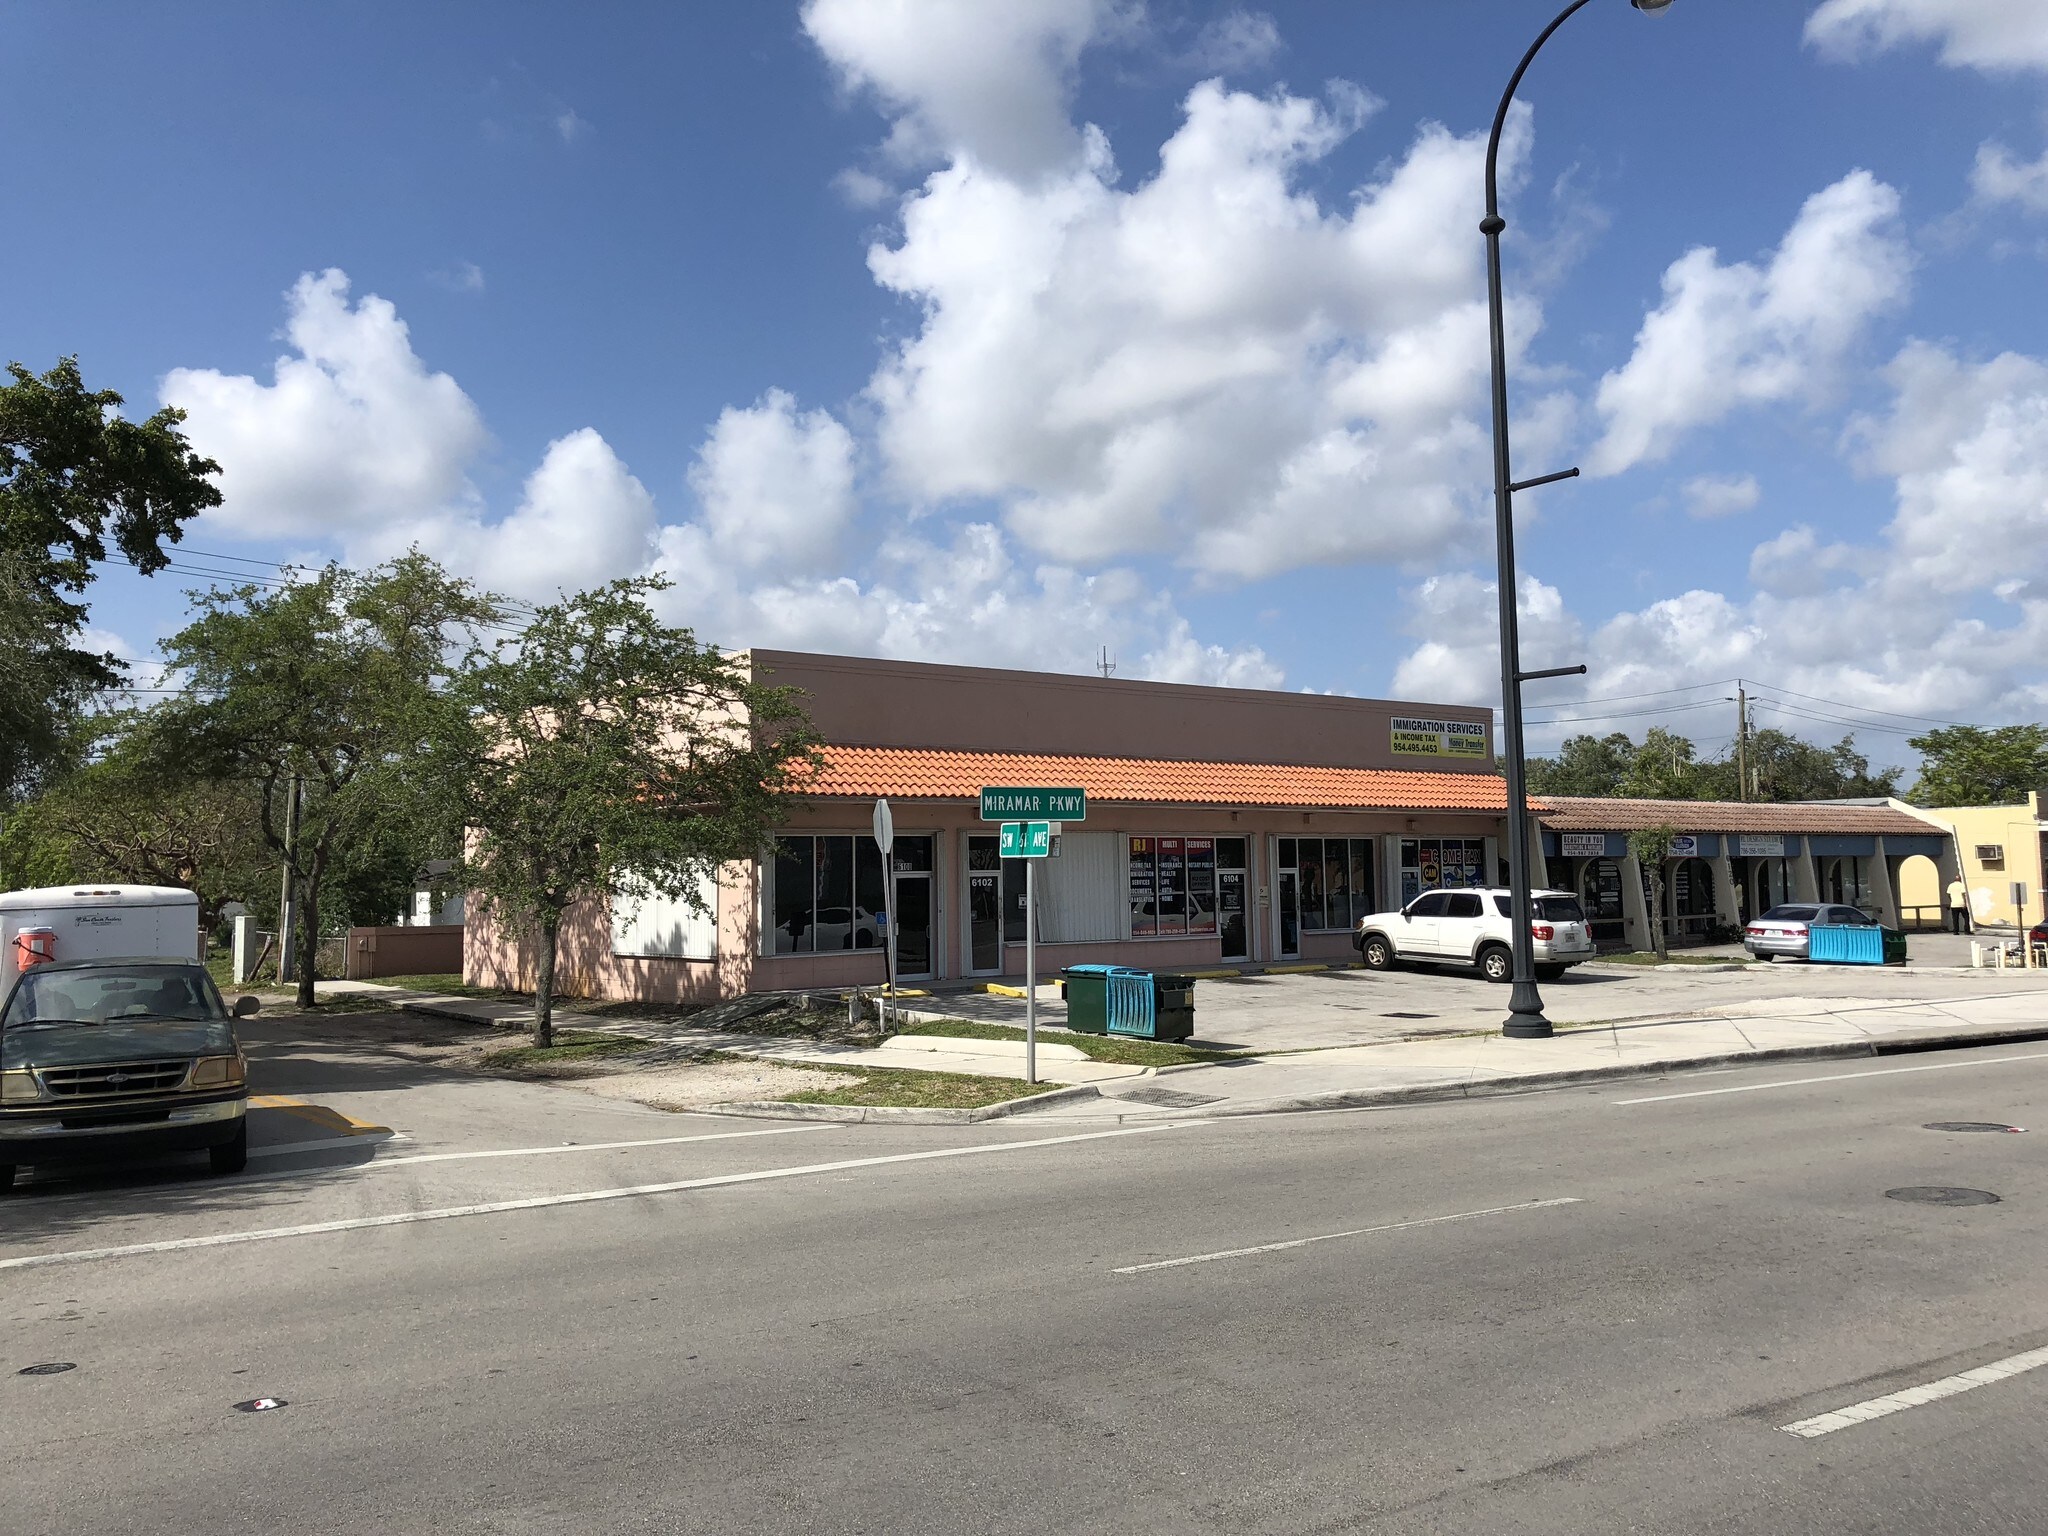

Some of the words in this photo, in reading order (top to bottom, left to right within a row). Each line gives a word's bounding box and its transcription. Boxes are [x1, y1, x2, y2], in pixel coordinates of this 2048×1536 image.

[1393, 719, 1445, 732] IMMIGRATION
[1447, 723, 1483, 735] SERVICES
[1400, 733, 1424, 742] INCOME
[1425, 734, 1436, 742] TAX
[1393, 742, 1438, 753] 954.495.4453
[984, 795, 1040, 811] MIRAMAR
[1049, 795, 1081, 811] PKWY
[1002, 832, 1014, 848] SW
[1032, 831, 1047, 847] AVE
[1133, 838, 1147, 851] RJ
[1162, 840, 1178, 848] MULTI
[1187, 840, 1211, 848] SERVICES
[971, 878, 993, 887] 6102
[1223, 874, 1239, 883] 6104
